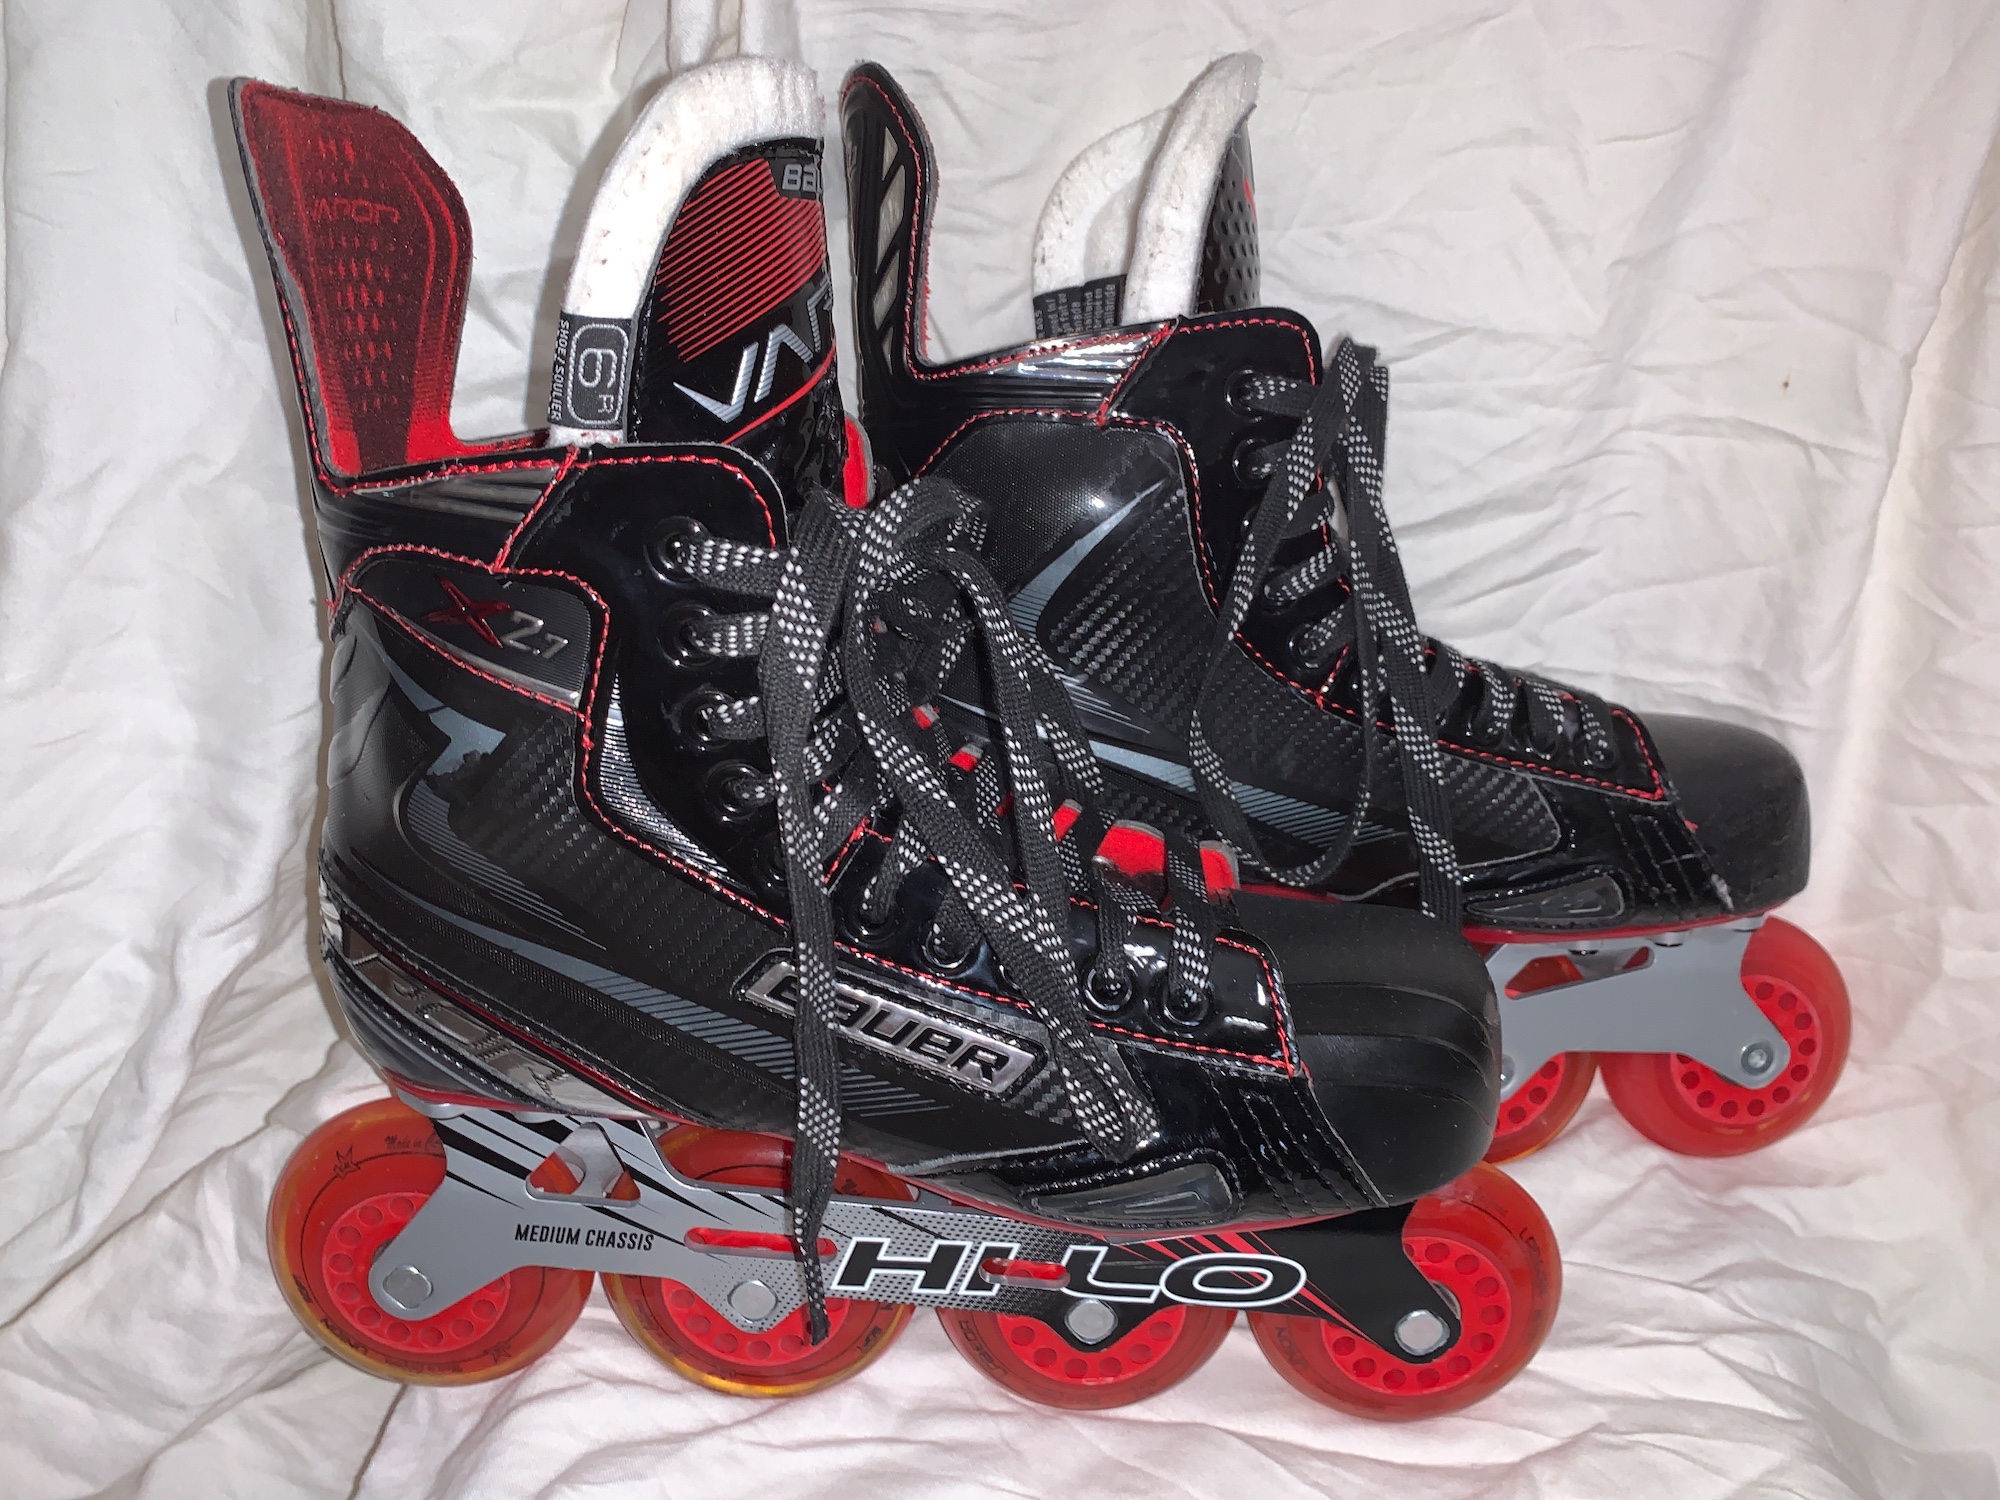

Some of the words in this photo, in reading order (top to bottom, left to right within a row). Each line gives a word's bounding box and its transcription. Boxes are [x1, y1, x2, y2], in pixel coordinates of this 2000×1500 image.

[1071, 301, 1083, 332] anada
[1104, 284, 1116, 326] ailande
[558, 320, 570, 356] SHOE
[579, 347, 617, 388] 6
[551, 363, 566, 420] SOULIER
[514, 1223, 581, 1245] MEDIUM
[585, 1229, 654, 1251] CHASSIS
